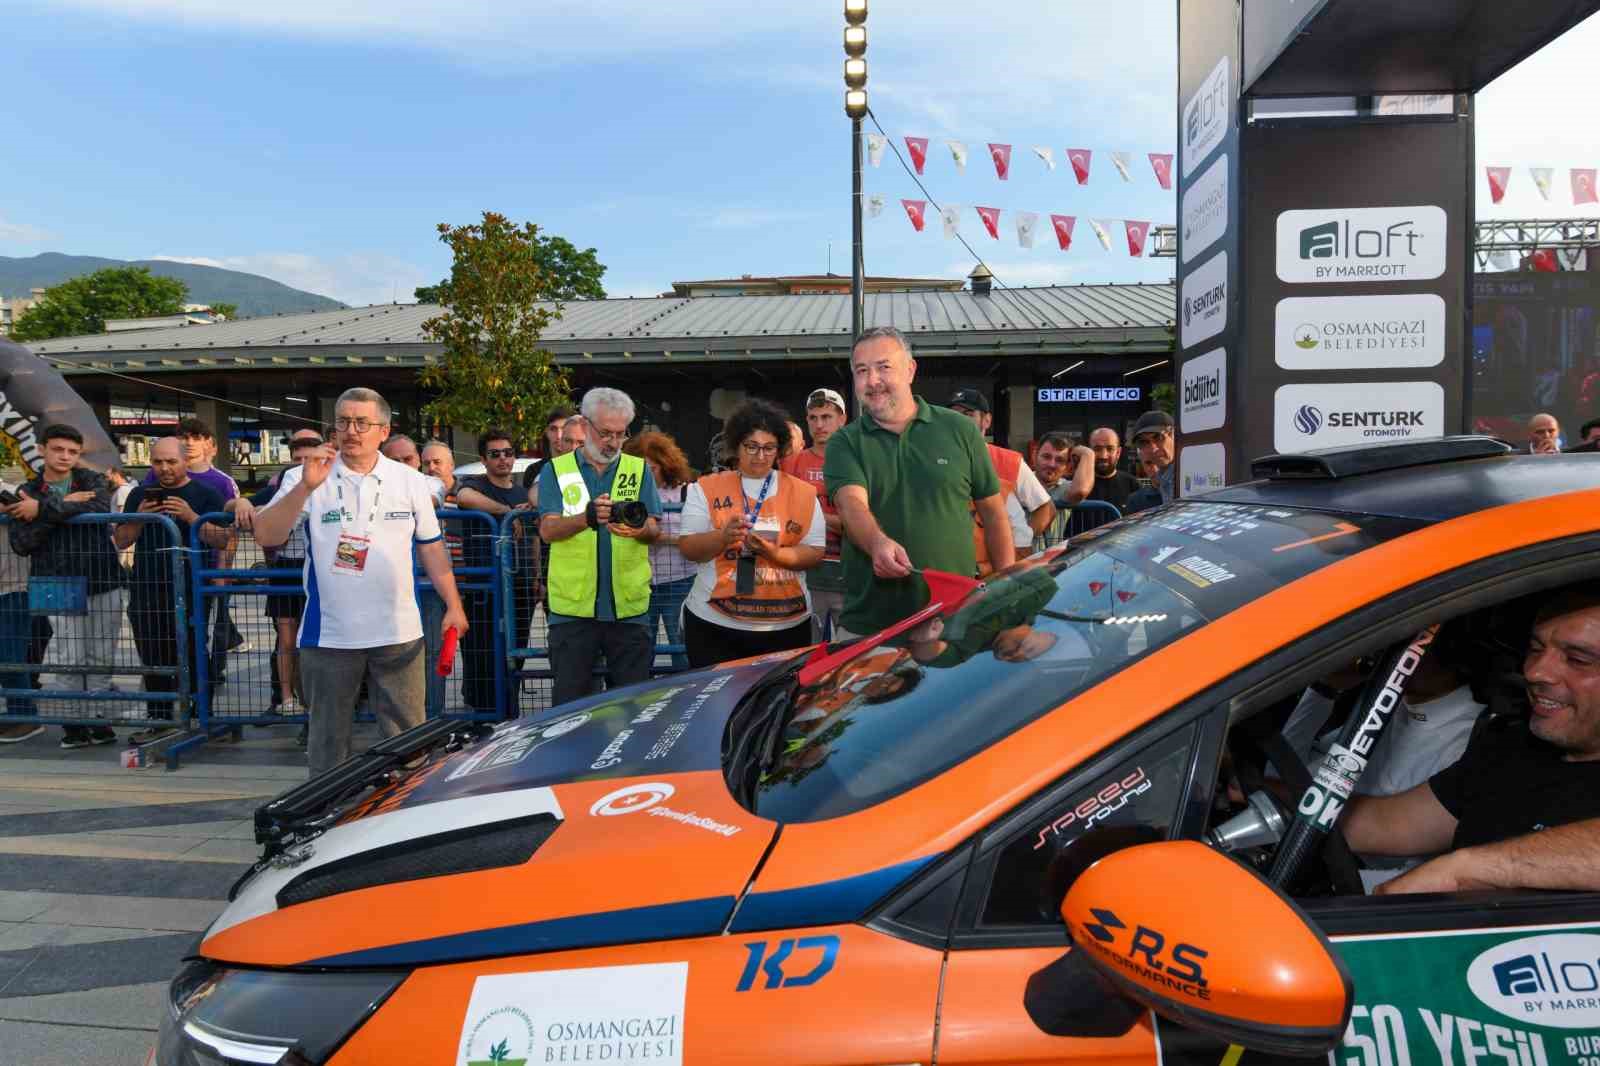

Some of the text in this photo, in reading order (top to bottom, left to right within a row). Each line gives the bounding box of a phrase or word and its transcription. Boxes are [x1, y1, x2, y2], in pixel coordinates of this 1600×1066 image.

[1300, 219, 1424, 260] aloft
[1316, 264, 1407, 278] BY MARRIOTT
[1038, 387, 1140, 402] STREETCO
[617, 472, 638, 489] 24
[713, 495, 733, 511] 44
[1493, 951, 1600, 998] alo
[1523, 1000, 1544, 1013] BY
